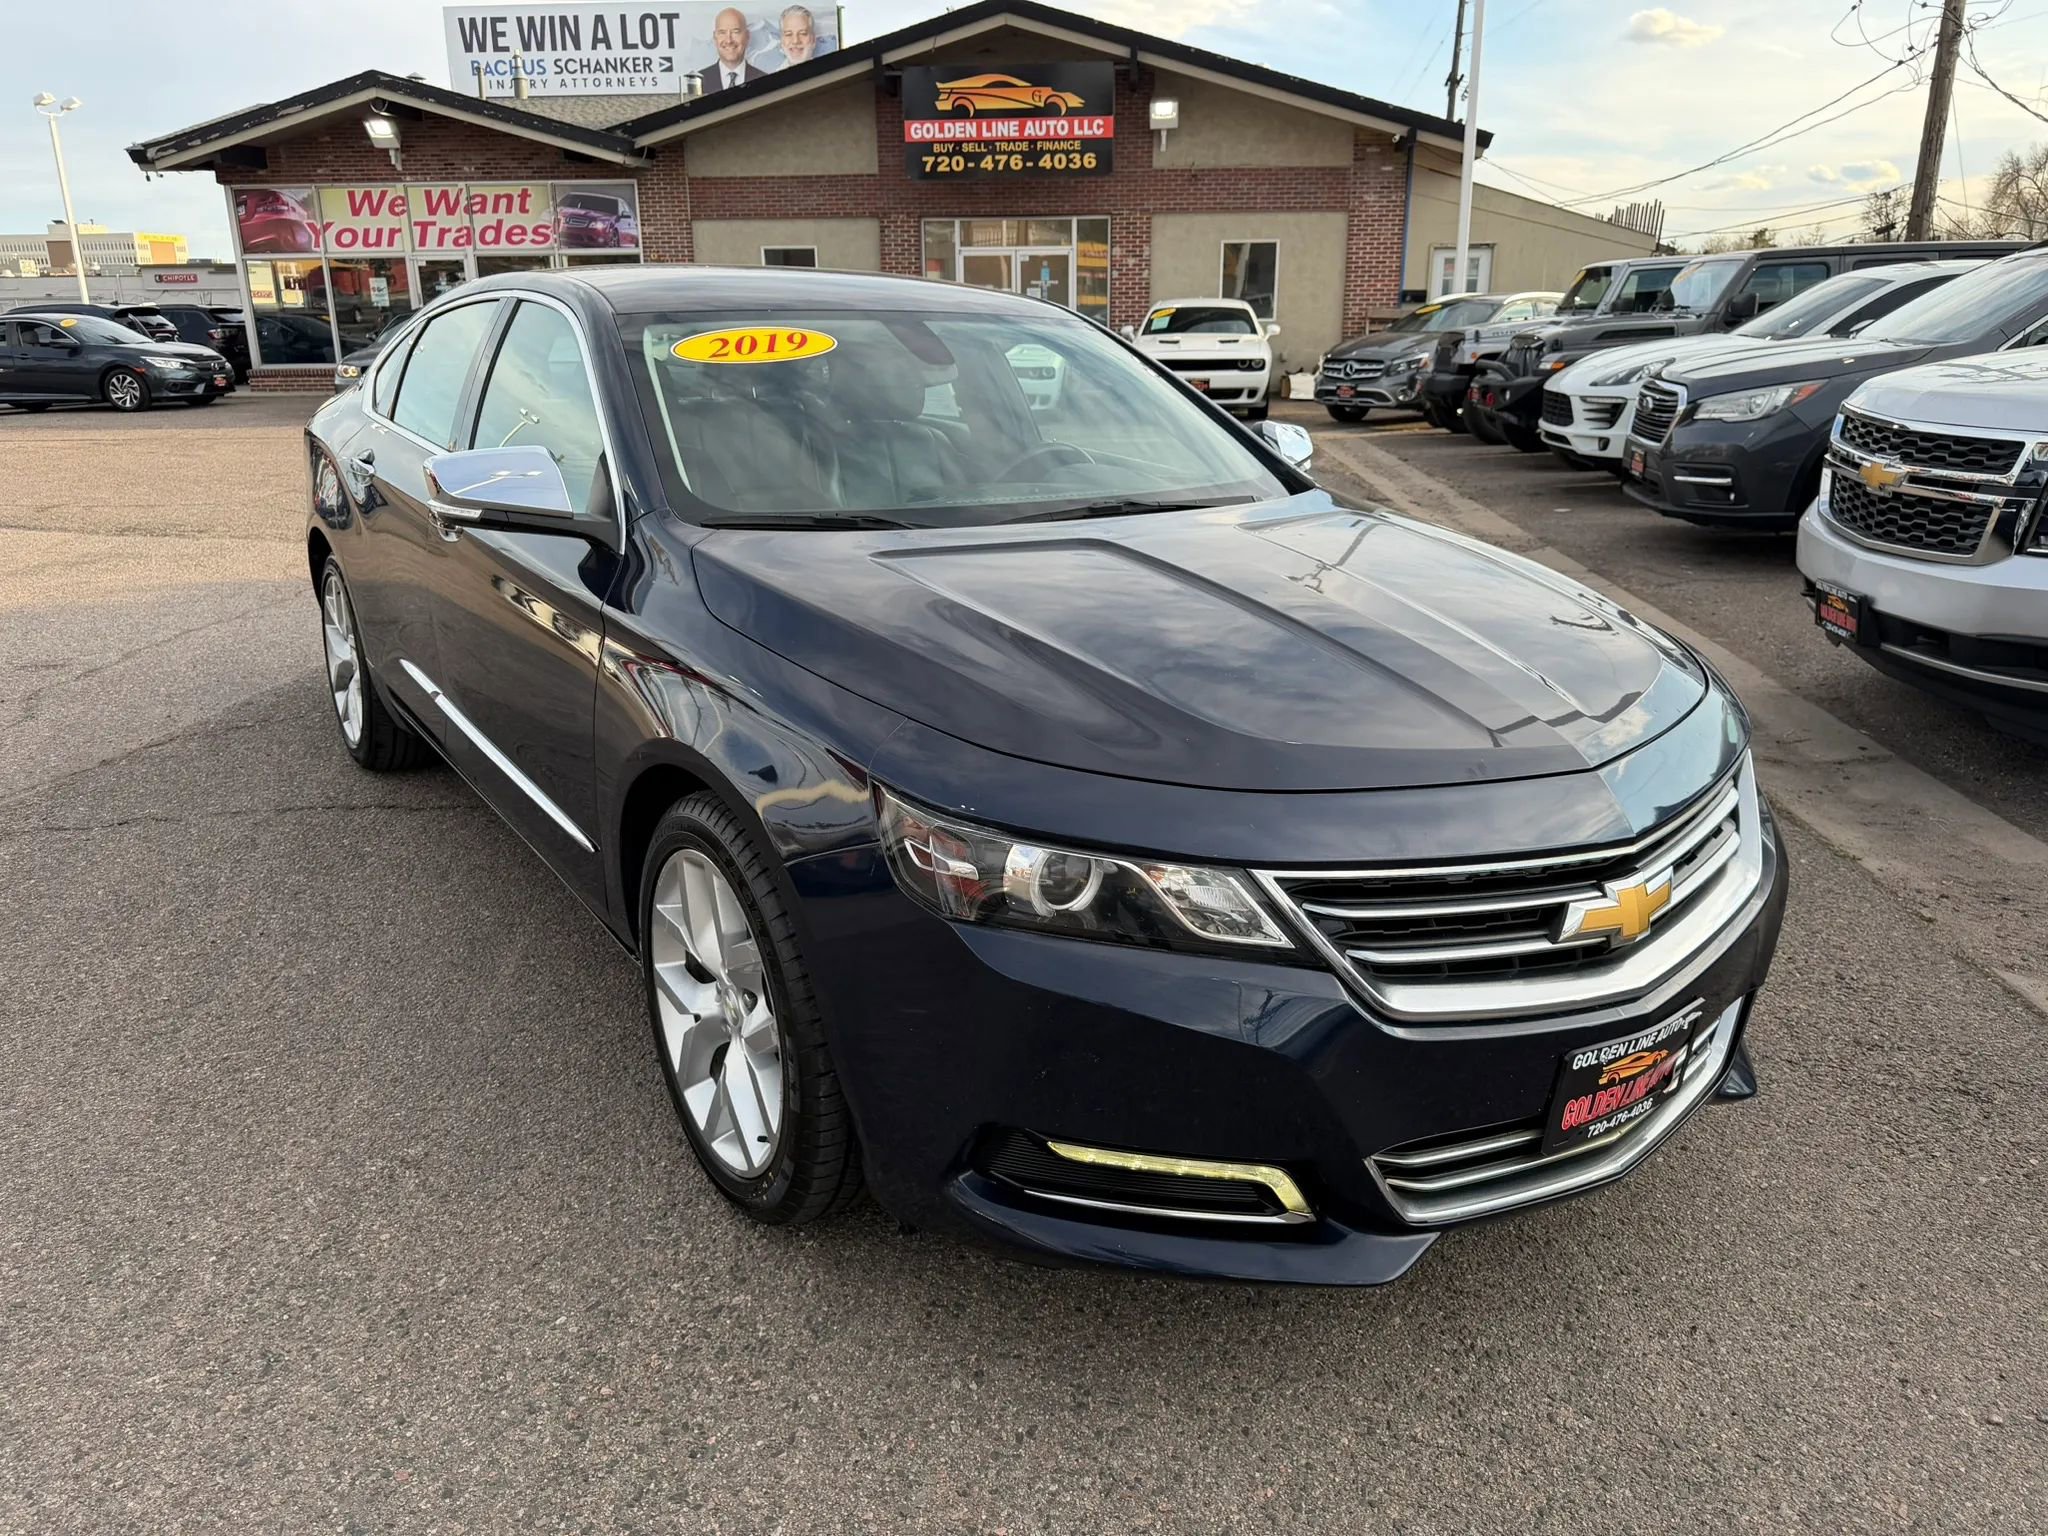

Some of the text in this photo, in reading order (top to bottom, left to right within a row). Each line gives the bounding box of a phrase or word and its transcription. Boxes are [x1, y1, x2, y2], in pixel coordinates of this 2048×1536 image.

[458, 13, 680, 53] WE WIN A LOT
[553, 56, 654, 75] SCHANKER
[489, 77, 659, 90] INJRY ATTORNEYS
[910, 119, 1105, 140] GOLDEN LINE AUTO LLC
[932, 140, 1082, 154] BUY SELL TRADE FINANCE
[346, 187, 532, 218] We Want
[305, 220, 402, 249] Your
[708, 331, 808, 359] 2019
[1572, 1042, 1629, 1071] GOLDEN
[1627, 1031, 1659, 1055] LINE
[1587, 1098, 1654, 1138] 720-476-4036
